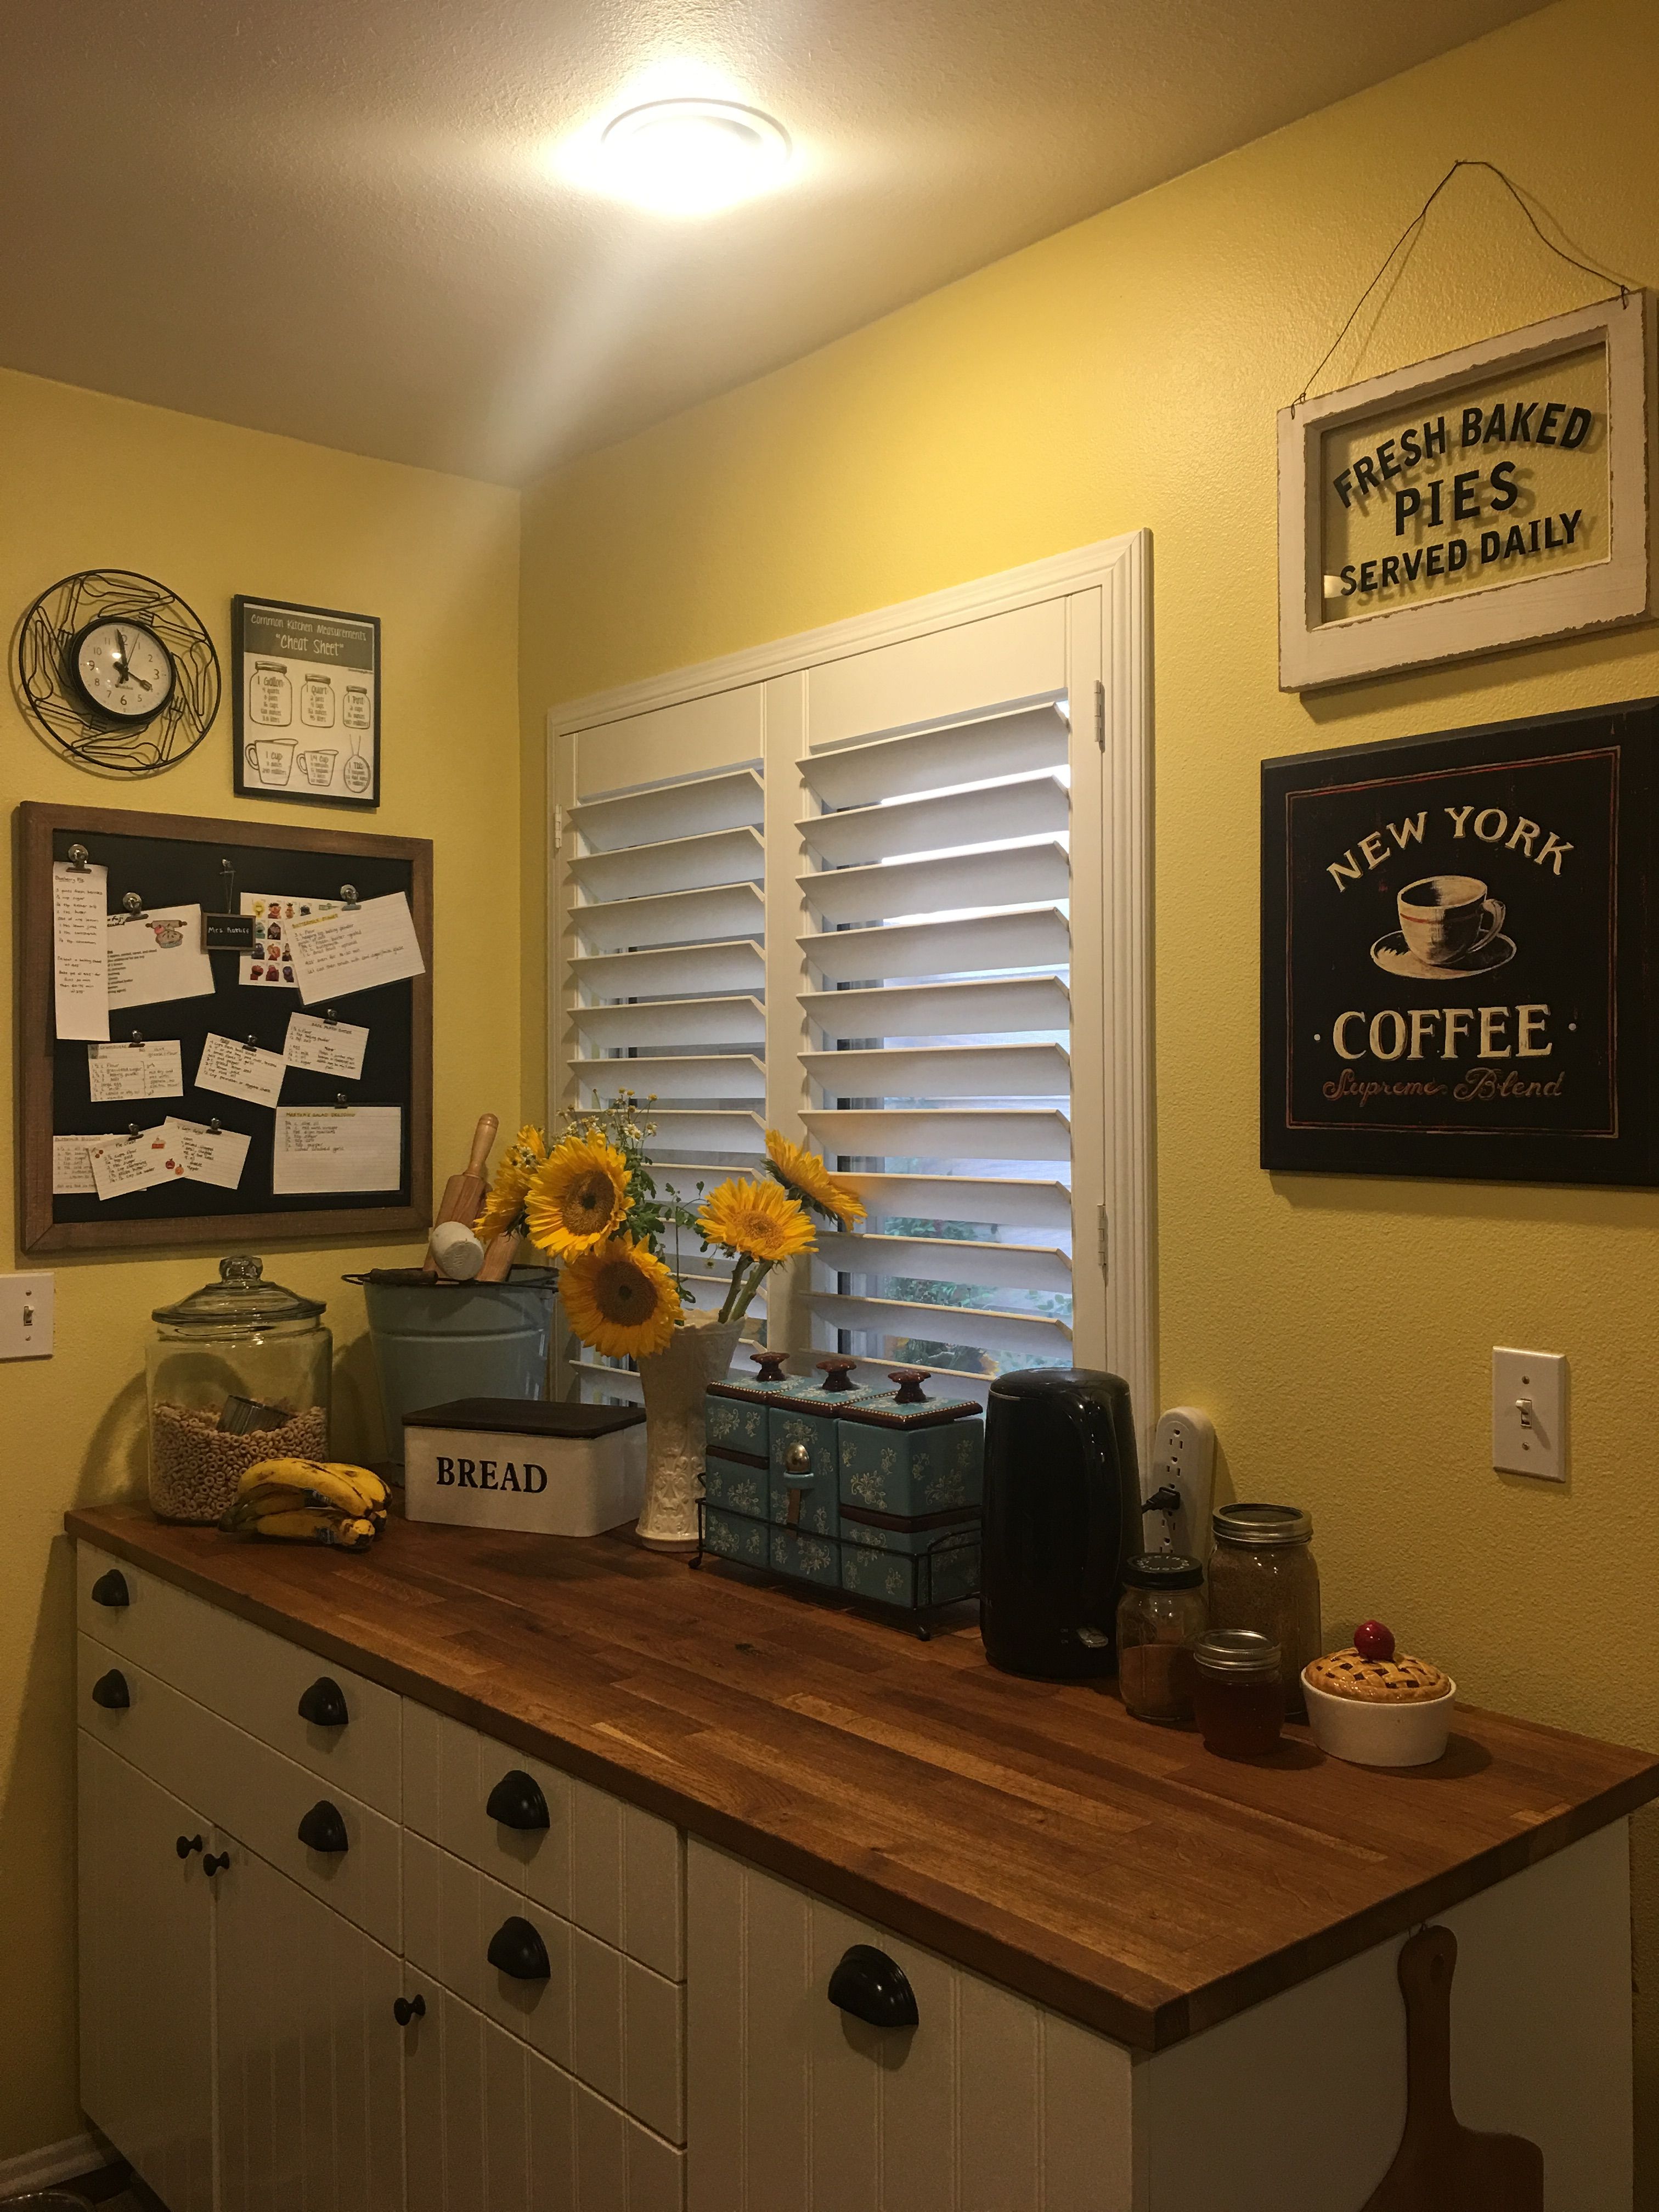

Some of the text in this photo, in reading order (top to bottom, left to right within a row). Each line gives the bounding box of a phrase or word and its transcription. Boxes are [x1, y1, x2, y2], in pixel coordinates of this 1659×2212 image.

[1333, 402, 1592, 509] FRESH BAKED
[1396, 461, 1518, 537] PIES
[1340, 509, 1583, 596] SERVED DAILY
[251, 614, 366, 641] Common Kitchen Measurements
[88, 660, 95, 671] 9
[94, 647, 102, 656] 10
[95, 678, 100, 686] 8
[154, 669, 160, 680] 3
[120, 695, 127, 706] 6
[1327, 806, 1575, 893] NEW YORK
[1333, 1003, 1553, 1061] COFFEE
[1322, 1066, 1565, 1108] Supreme Blend
[436, 1457, 548, 1493] BREAD
